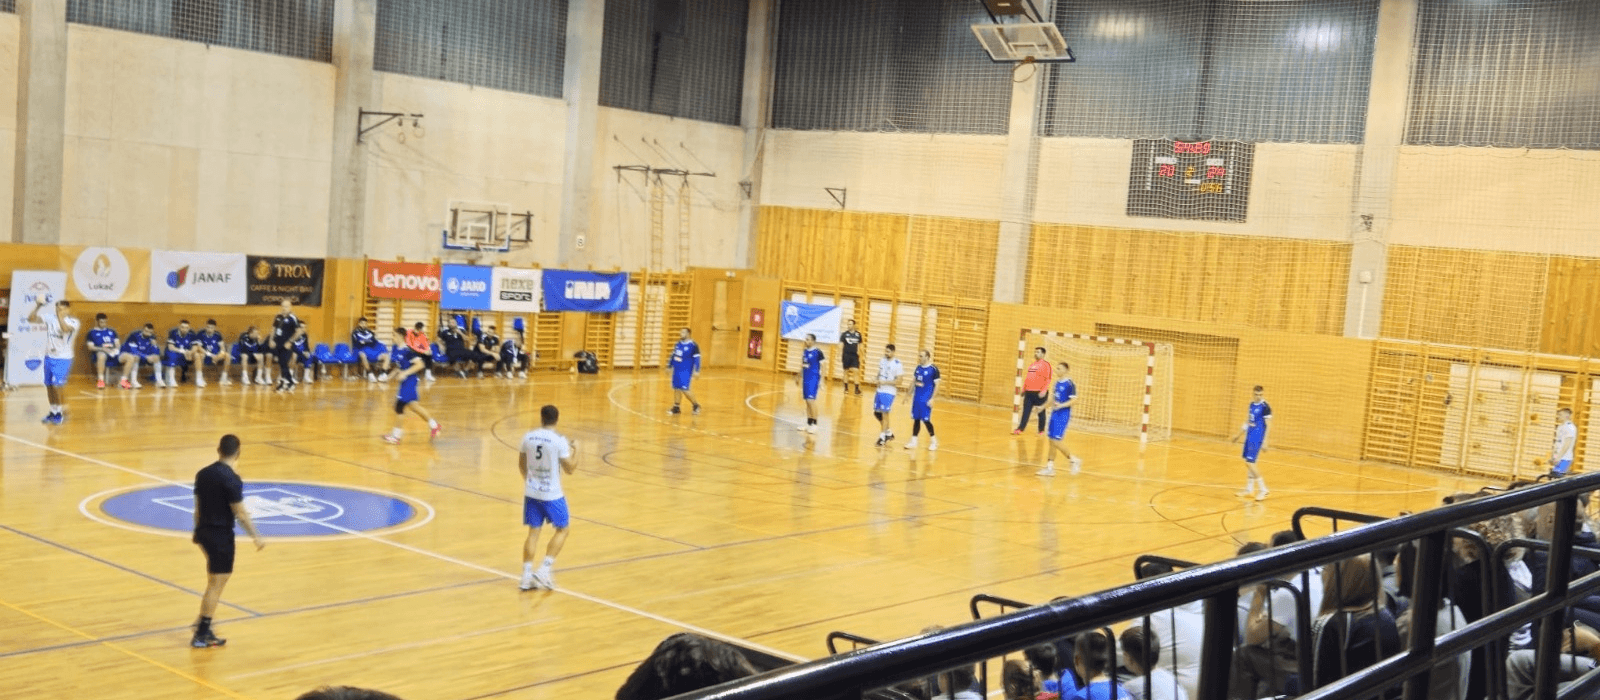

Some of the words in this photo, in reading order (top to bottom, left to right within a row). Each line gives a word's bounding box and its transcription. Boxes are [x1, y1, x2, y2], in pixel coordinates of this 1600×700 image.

[192, 272, 232, 284] JANAF
[274, 264, 312, 279] TRON
[372, 268, 440, 291] Lenovo
[501, 278, 534, 290] nexe
[536, 445, 543, 460] 5
